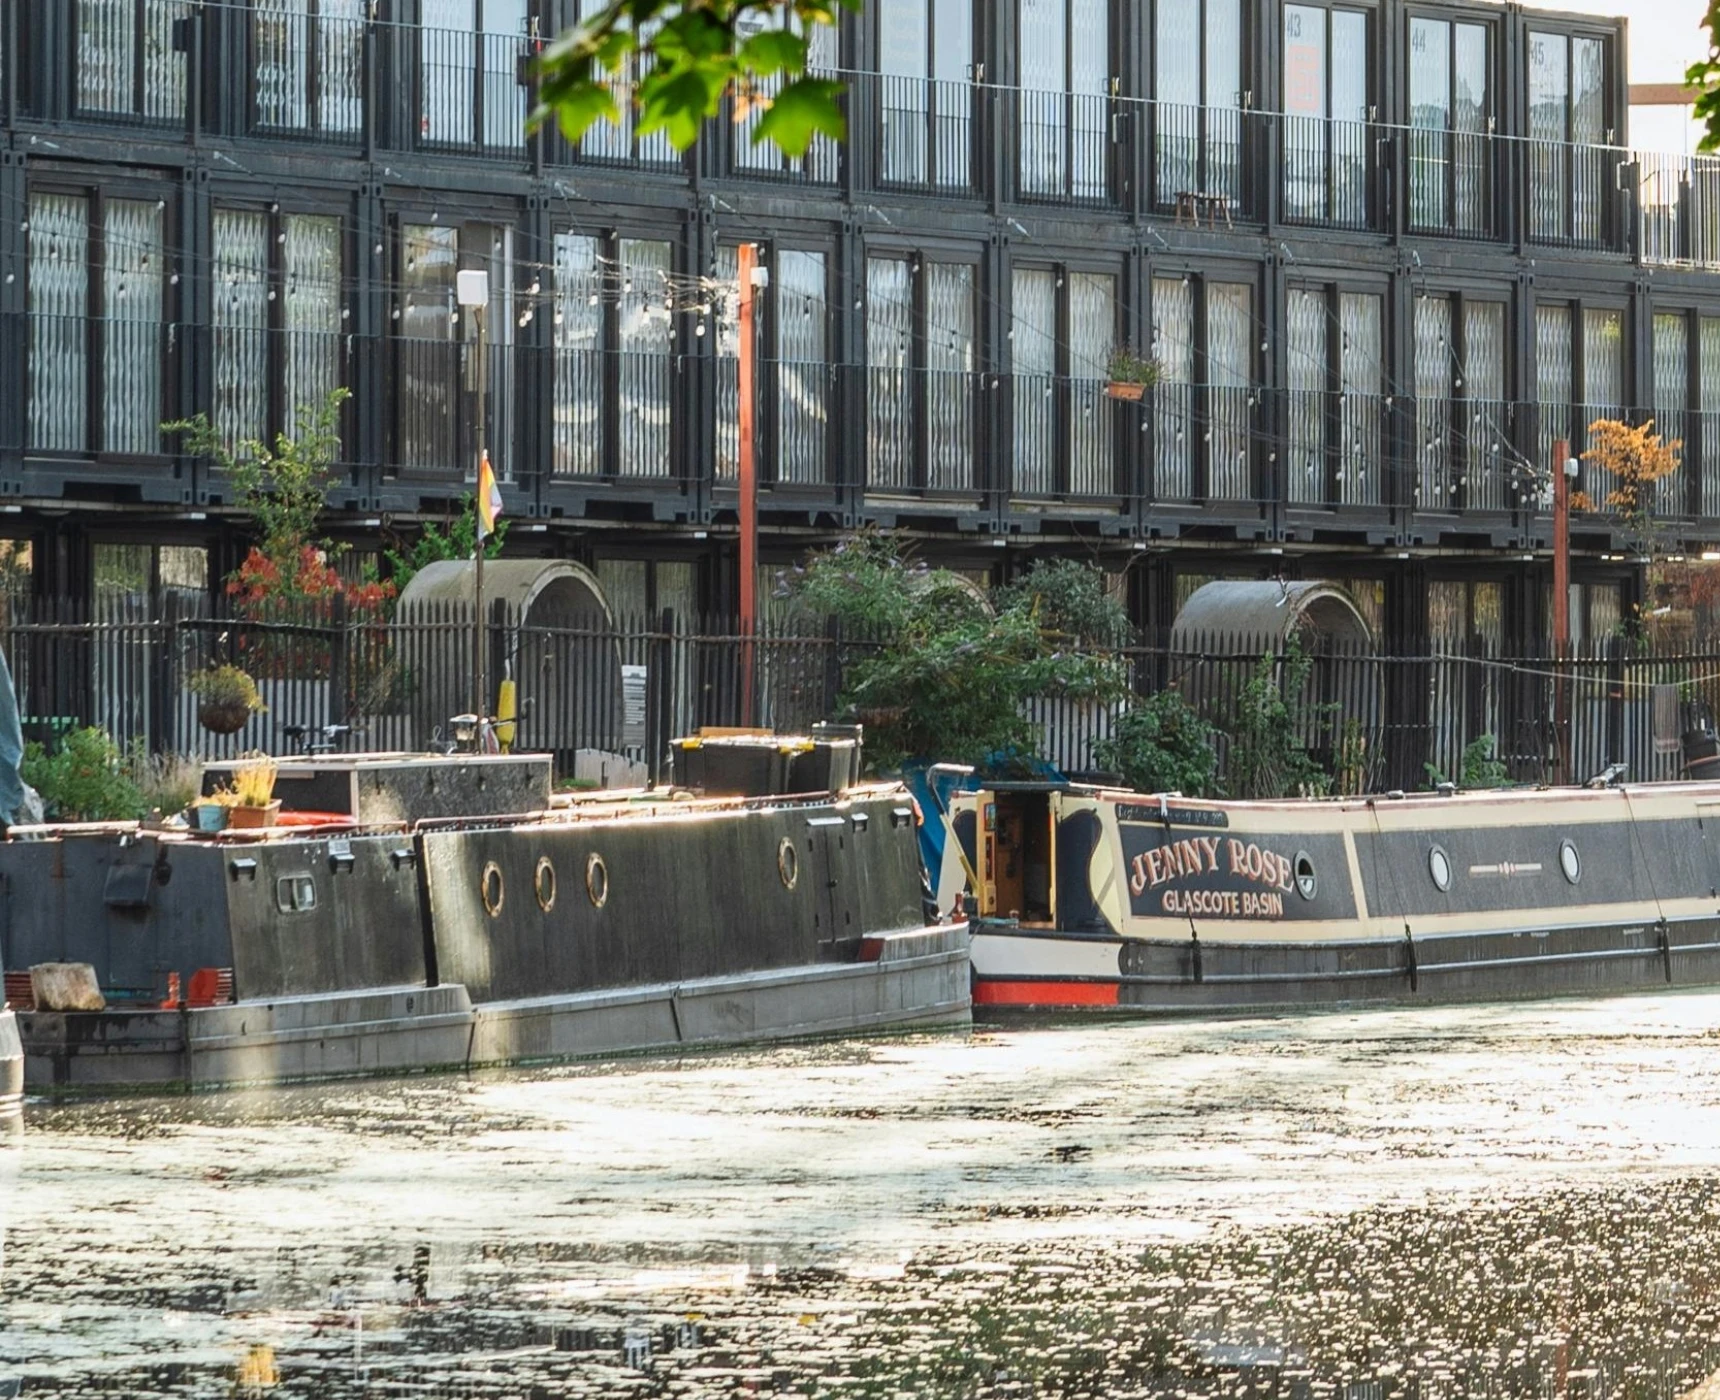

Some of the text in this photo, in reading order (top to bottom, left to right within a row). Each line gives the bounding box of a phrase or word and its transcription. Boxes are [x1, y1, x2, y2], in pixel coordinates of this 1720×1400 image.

[1286, 12, 1302, 38] 43
[1411, 27, 1426, 53] 44
[1530, 40, 1545, 66] 45
[1130, 836, 1294, 896] JENNY ROSE
[1162, 889, 1284, 916] GLASCOTE BASIN
